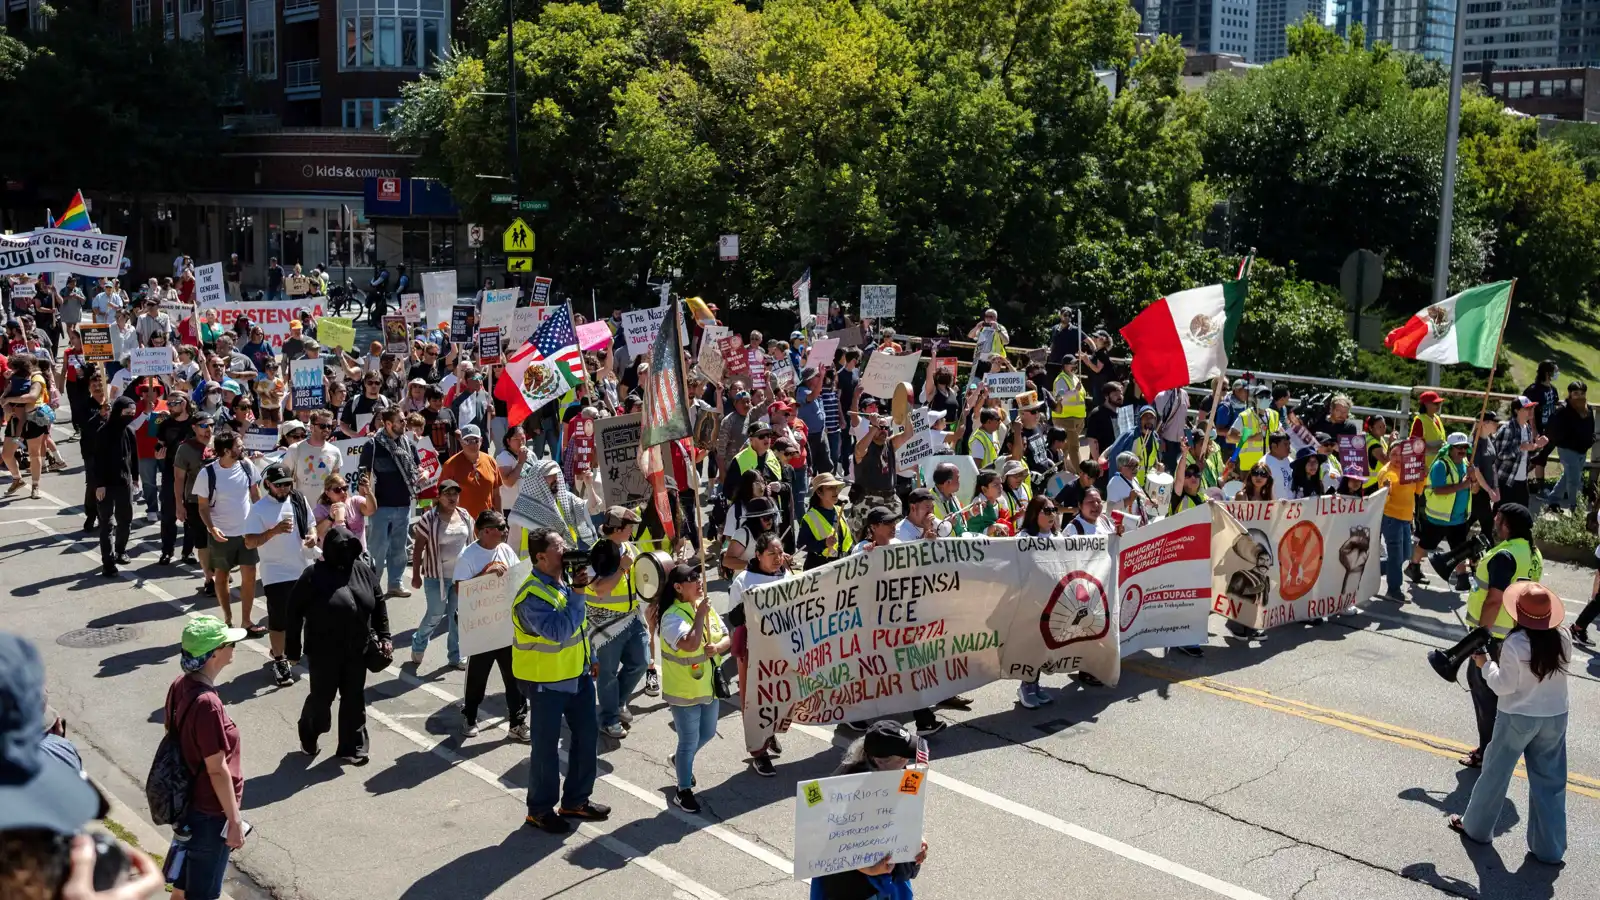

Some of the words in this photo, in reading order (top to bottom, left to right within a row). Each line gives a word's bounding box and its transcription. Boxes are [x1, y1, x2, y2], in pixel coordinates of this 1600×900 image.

[43, 235, 79, 248] Guard
[82, 240, 93, 249] &
[96, 240, 118, 252] ICE
[0, 249, 31, 270] OUT
[36, 246, 52, 260] of
[53, 247, 114, 266] Chicago!
[199, 267, 214, 276] BUILD
[203, 275, 213, 283] THE
[199, 283, 220, 293] GENERAL
[203, 292, 220, 302] STRIKE
[486, 292, 512, 303] Believe
[626, 313, 645, 324] The
[628, 325, 648, 334] were
[649, 321, 661, 331] als
[988, 377, 998, 385] NO
[998, 376, 1020, 385] TROOPS
[294, 389, 310, 398] JOBS
[295, 396, 323, 407] JUSTICE
[900, 442, 930, 459] FAMILIES
[906, 438, 923, 450] KEEP
[899, 448, 933, 466] TOGETHER
[1286, 502, 1304, 520] ES
[1315, 496, 1366, 516] ILEGAL
[1017, 537, 1057, 552] CASA
[1064, 537, 1107, 552] DUPAGE
[1124, 538, 1166, 560] IMMIGRANT
[1123, 547, 1163, 570] SOLIDARITY
[1132, 556, 1161, 573] DUPAGE
[1162, 552, 1178, 561] LUCHA
[834, 554, 870, 585] TUS
[759, 596, 825, 637] COMITES
[835, 585, 859, 612] DE
[875, 571, 961, 602] DEFENSA
[1144, 593, 1162, 602] CASA
[1162, 590, 1198, 600] DUPAGE
[1213, 594, 1244, 620] EN
[1261, 605, 1296, 629] TIERRA
[1307, 591, 1358, 619] ROBADA
[790, 628, 805, 655] SI
[810, 606, 863, 645] LLEGA
[877, 600, 917, 625] ICE
[758, 659, 789, 682] NO
[839, 633, 862, 659] LA
[757, 680, 793, 706] NO
[858, 653, 888, 679] NO
[893, 637, 946, 671] FIRMAR
[759, 705, 779, 729] SI
[829, 674, 902, 706] HABLAR
[910, 668, 939, 692] CON
[945, 656, 970, 682] UN
[830, 789, 889, 803] PATRIOTS
[827, 811, 865, 824] RESIST
[877, 807, 896, 816] THE
[882, 821, 894, 830] OF
